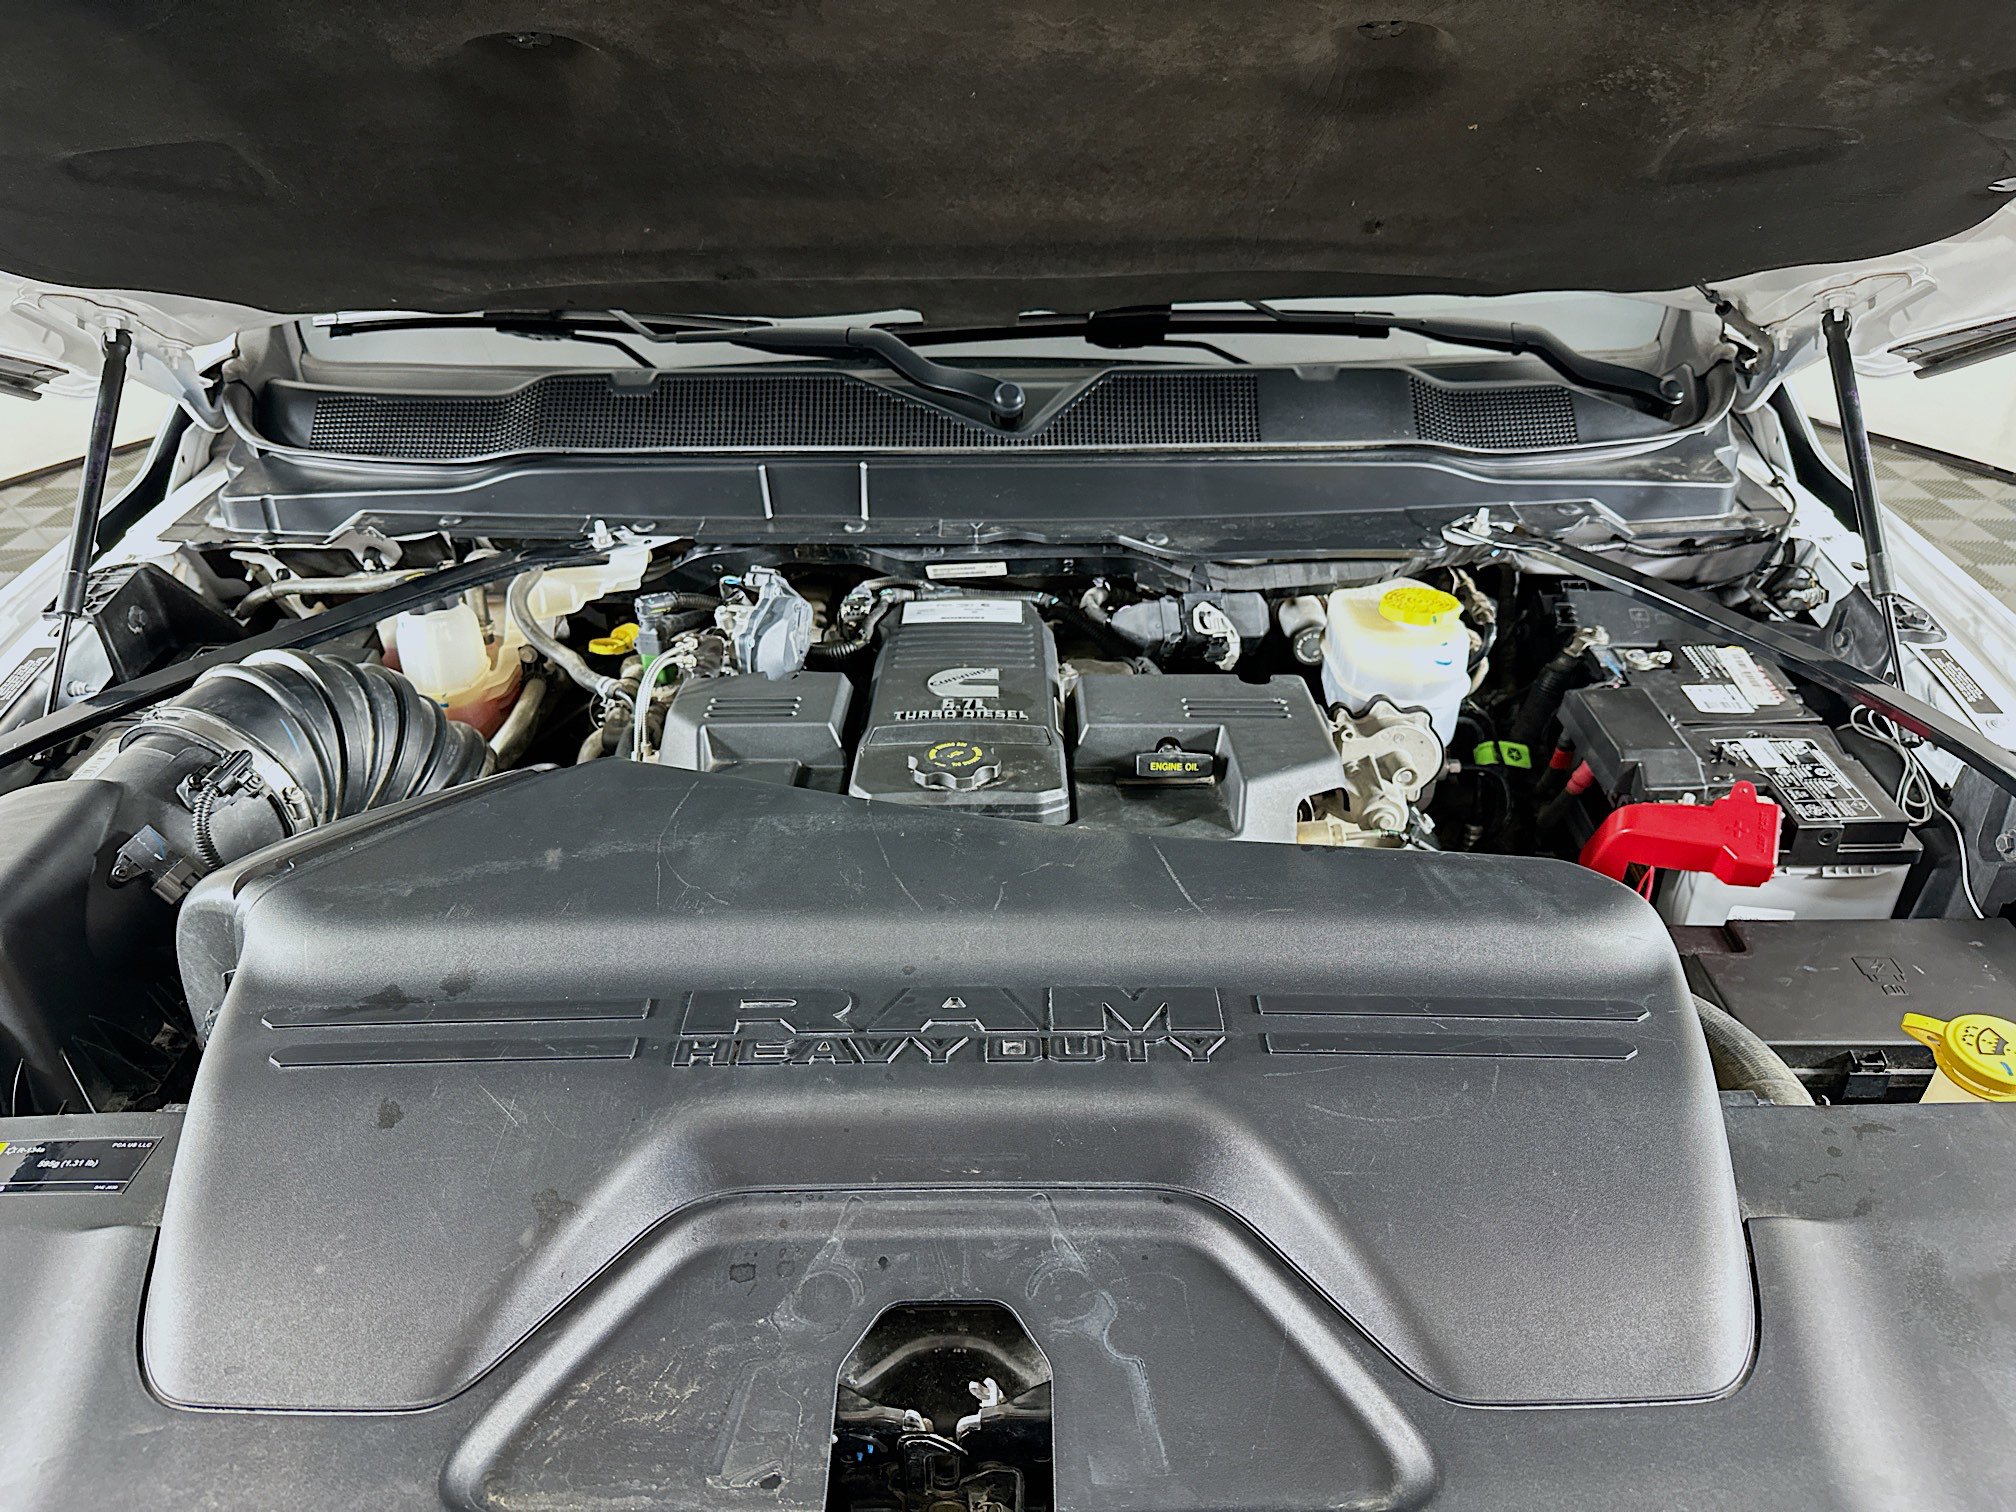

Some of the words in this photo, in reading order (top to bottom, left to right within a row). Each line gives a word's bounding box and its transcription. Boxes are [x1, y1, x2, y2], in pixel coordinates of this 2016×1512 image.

[942, 698, 987, 710] 6.7L
[894, 709, 957, 720] TURBO
[962, 709, 1029, 720] DIESEL
[1149, 761, 1183, 772] ENGINE
[1184, 762, 1200, 772] OIL
[680, 985, 1226, 1035] RAM
[671, 1036, 969, 1067] HEAVY
[984, 1035, 1227, 1064] DUTY
